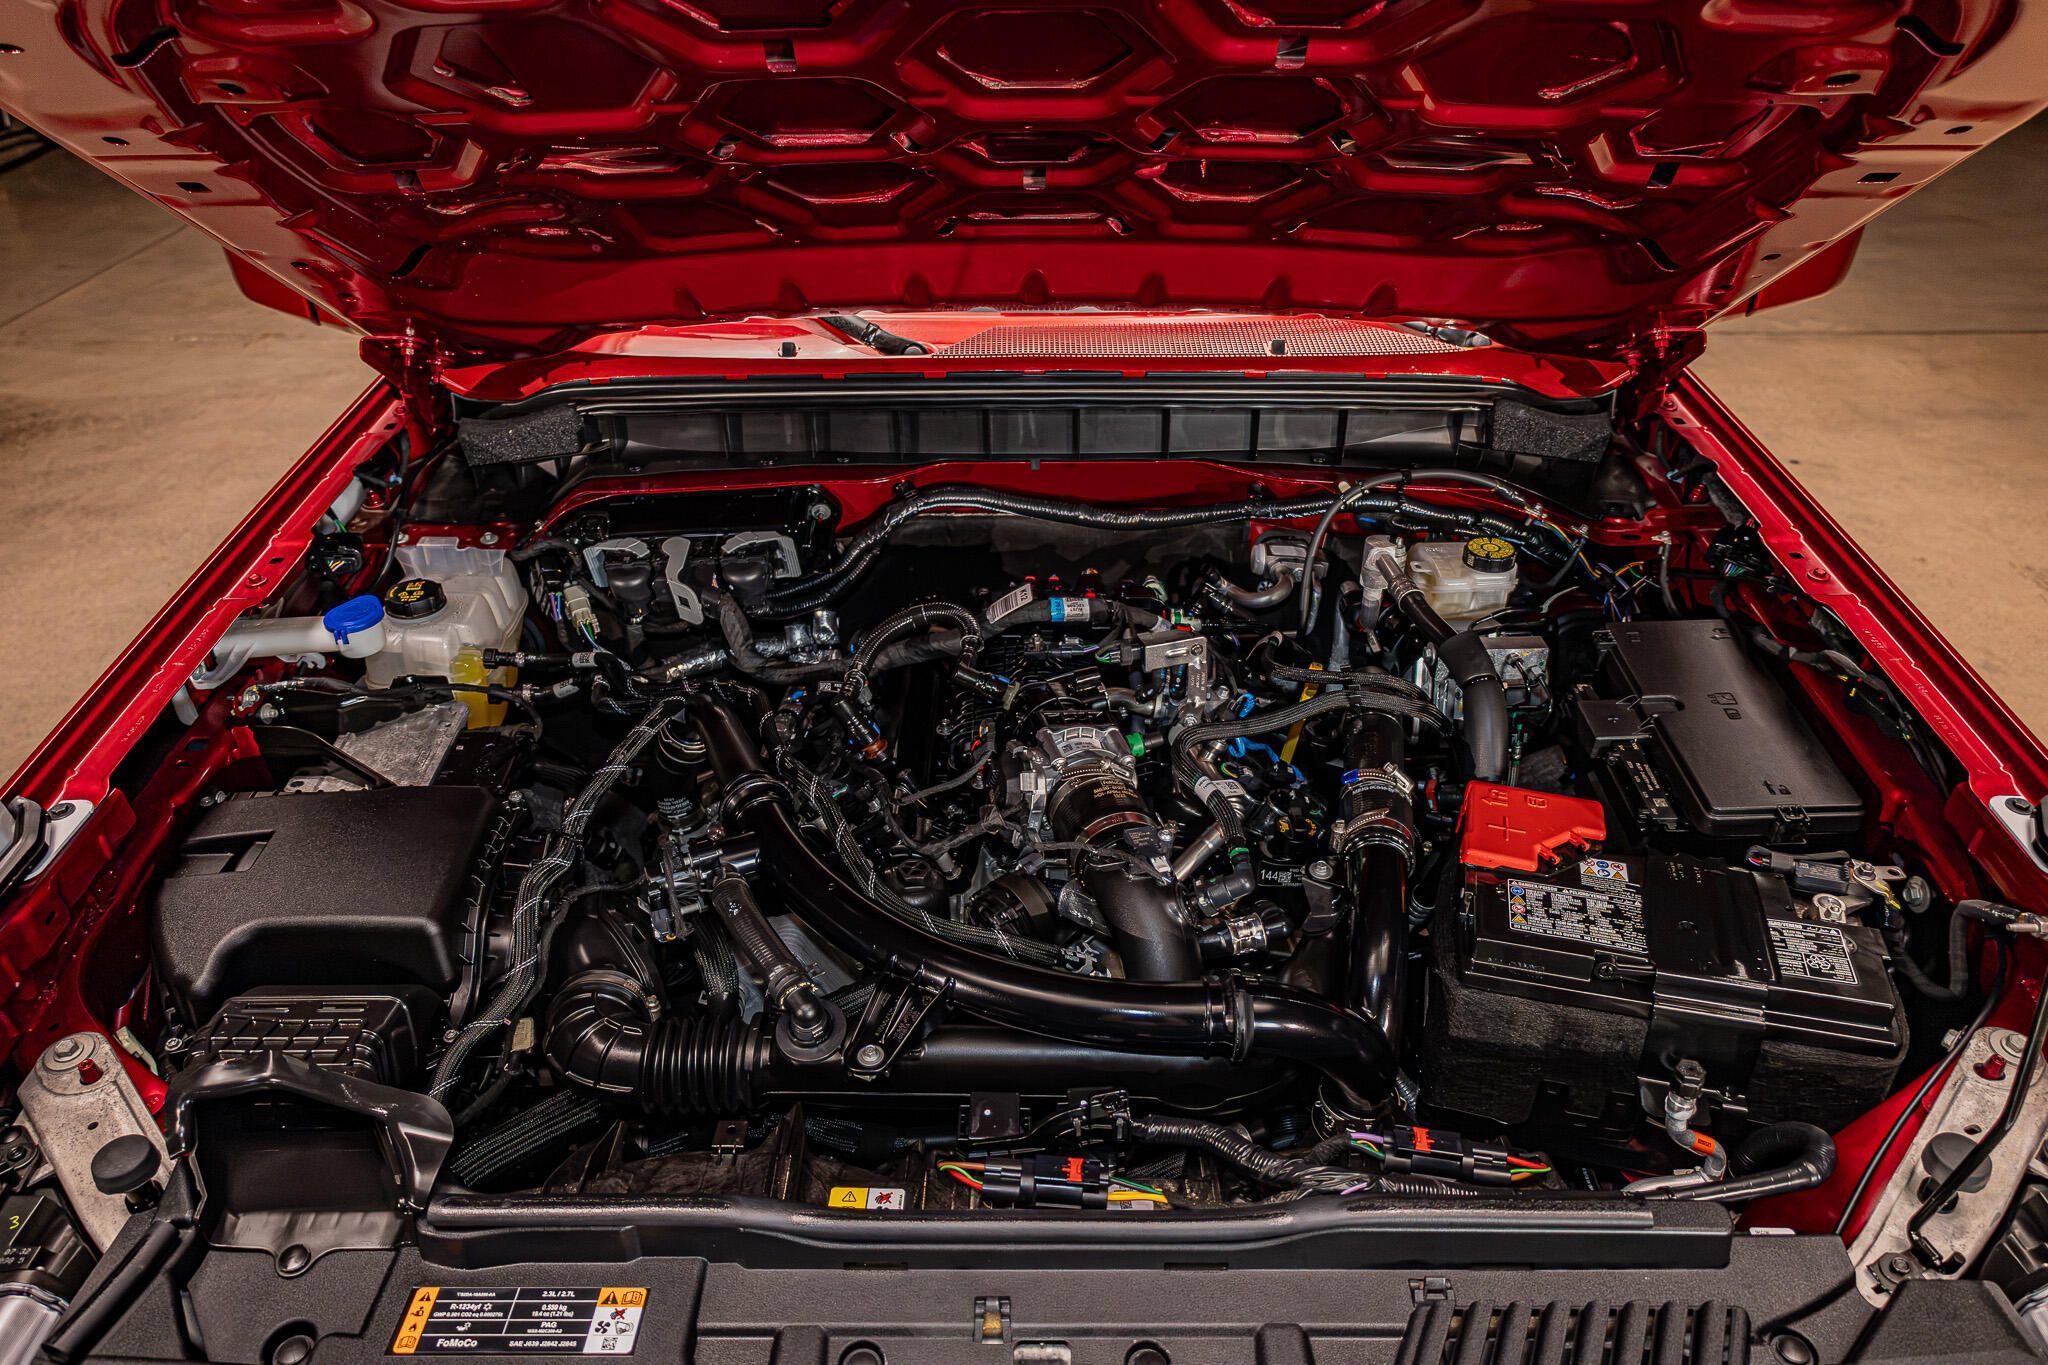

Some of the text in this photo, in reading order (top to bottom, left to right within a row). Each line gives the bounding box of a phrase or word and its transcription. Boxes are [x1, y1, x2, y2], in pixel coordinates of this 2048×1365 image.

[1260, 869, 1278, 881] 144
[8, 1215, 20, 1230] 3
[449, 1303, 482, 1312] R-1234yf
[436, 1338, 478, 1348] FoMoCo
